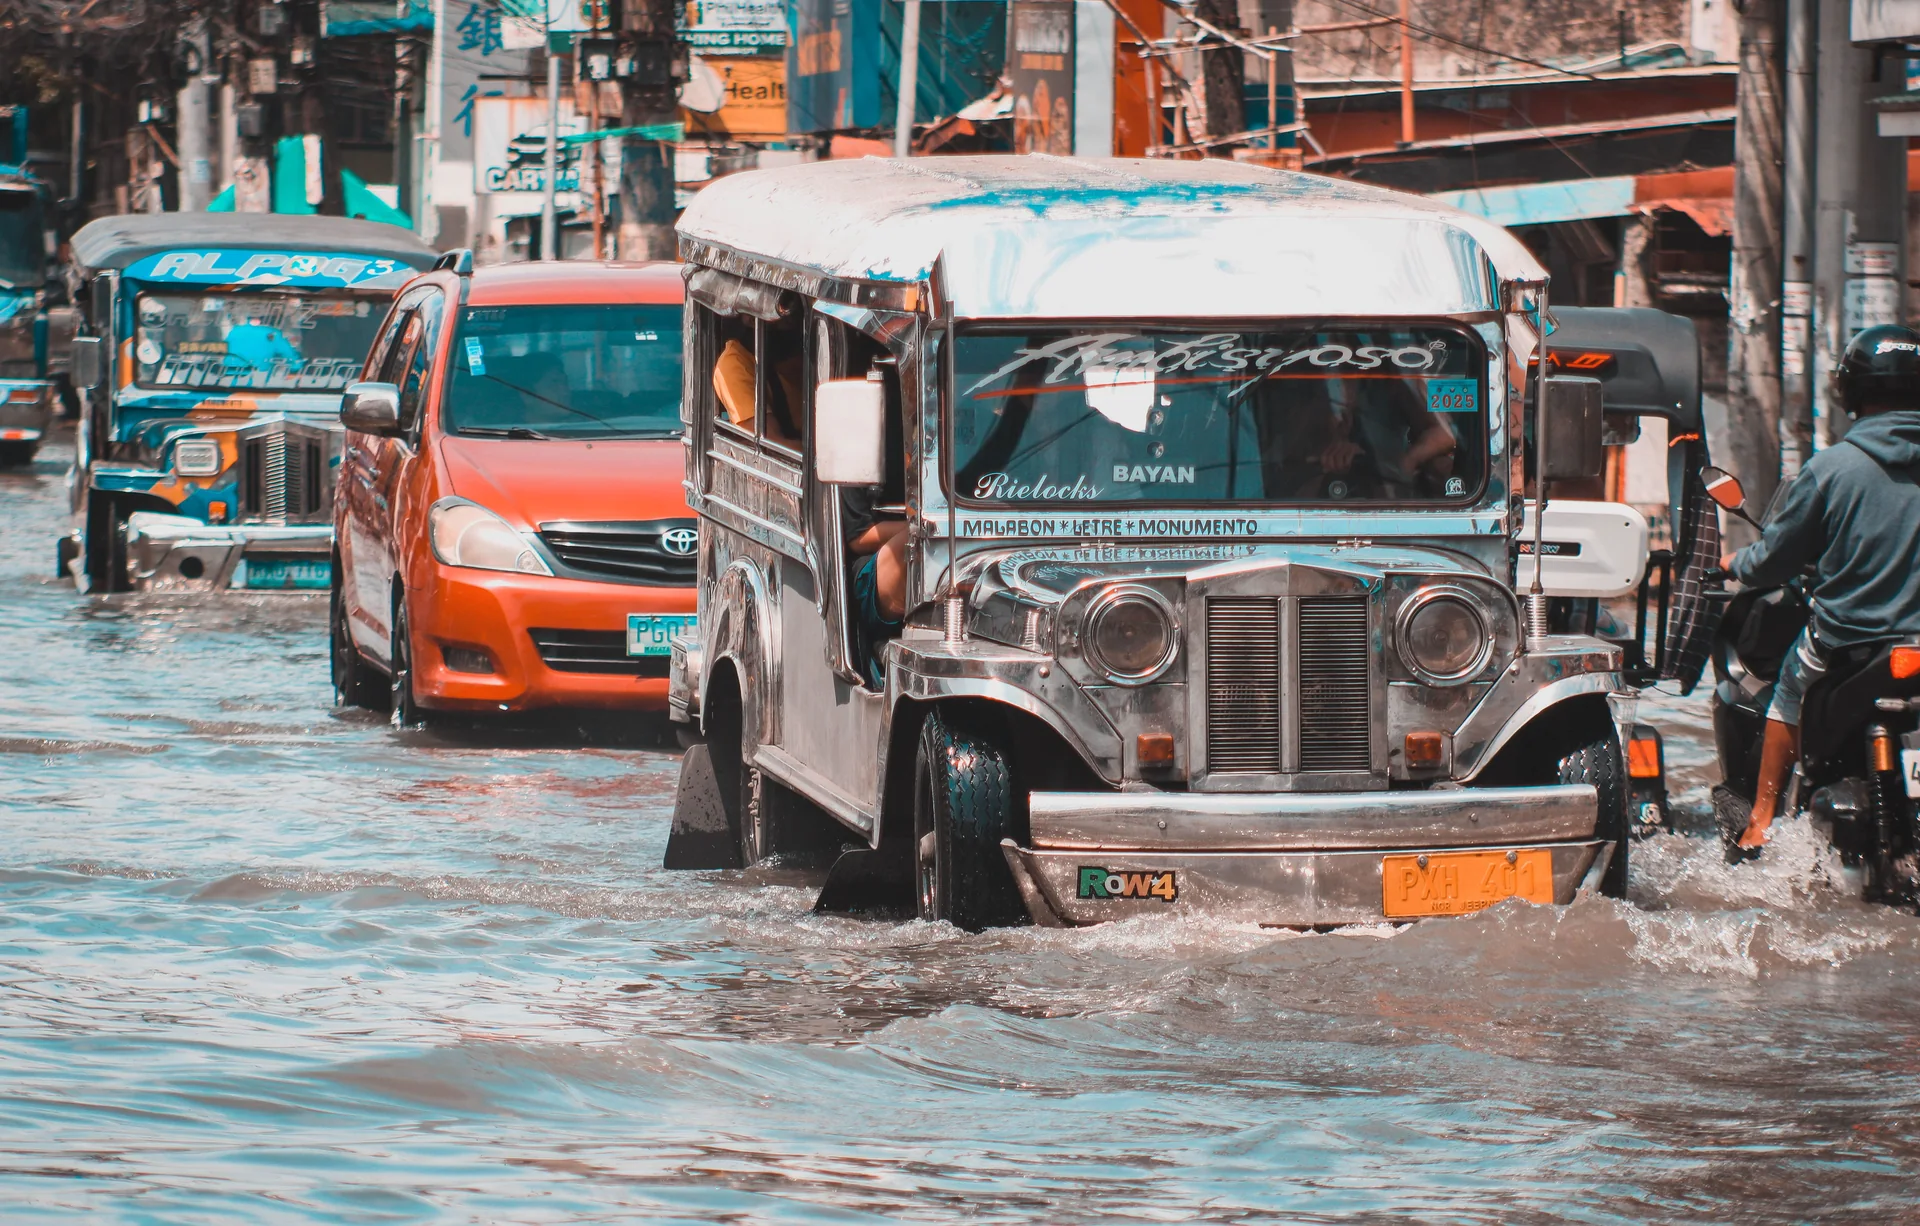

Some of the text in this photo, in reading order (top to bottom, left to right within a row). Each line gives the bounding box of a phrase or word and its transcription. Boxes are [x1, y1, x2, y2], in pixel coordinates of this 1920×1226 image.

[733, 32, 785, 46] HOME
[1431, 394, 1475, 409] 2025
[1112, 464, 1196, 484] BAYAN
[973, 471, 1105, 500] Rielocks
[962, 518, 1258, 537] MALABON LETRE MONUMENTO
[1400, 860, 1535, 902] PXH 401
[1459, 899, 1505, 911] JEEPN
